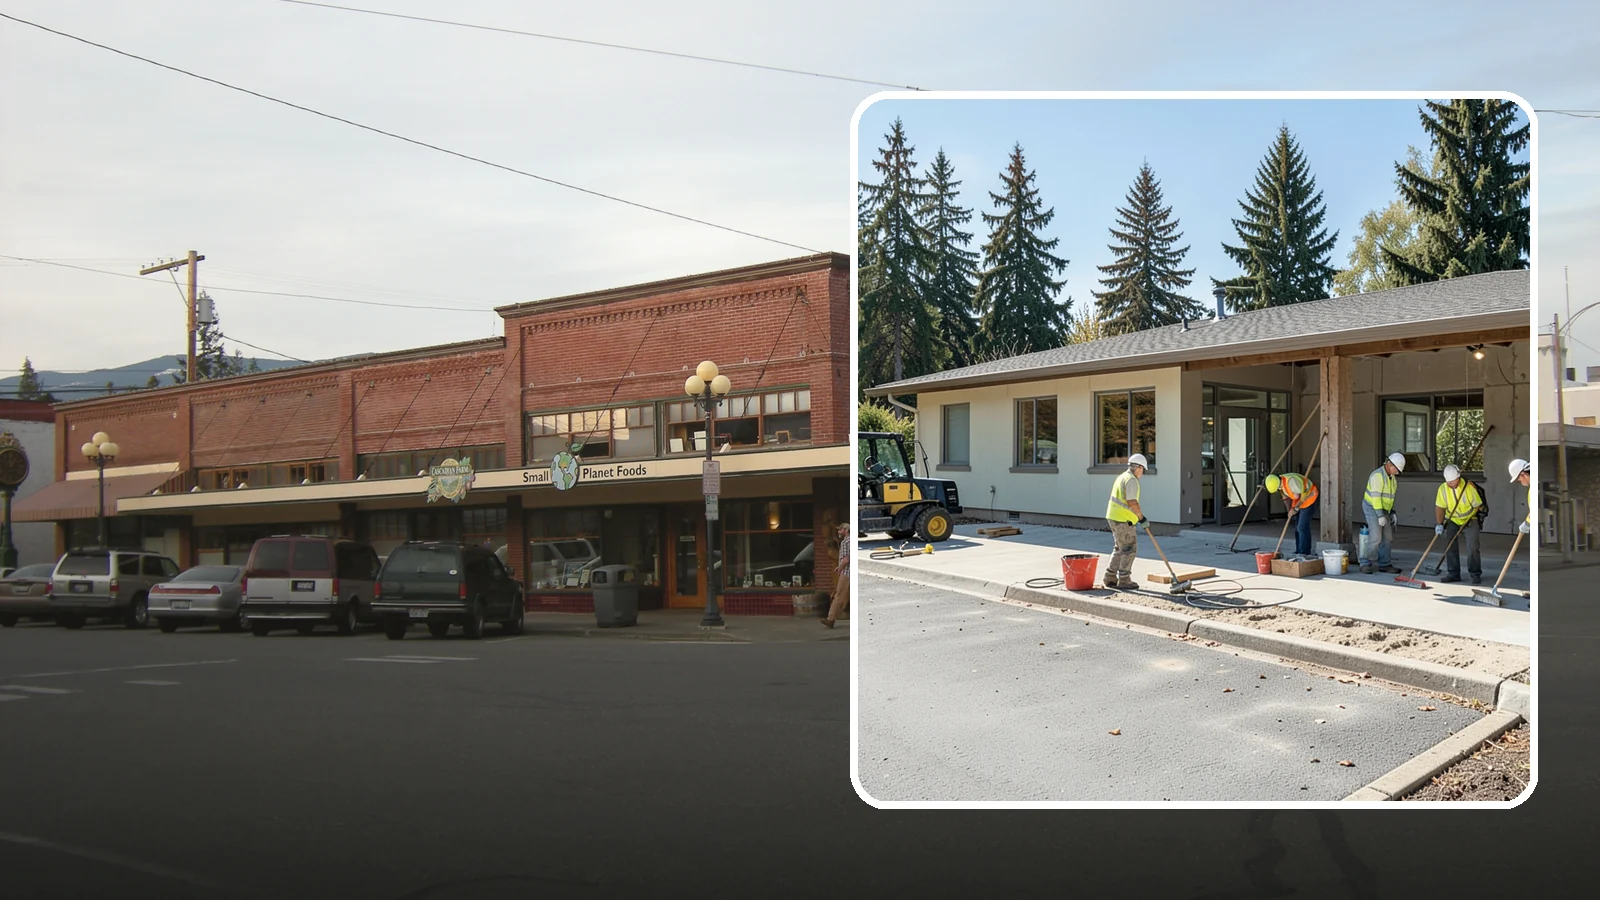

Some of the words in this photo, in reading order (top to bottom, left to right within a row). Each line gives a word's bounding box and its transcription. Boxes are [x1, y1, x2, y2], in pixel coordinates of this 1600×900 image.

[523, 471, 549, 483] Small
[583, 467, 614, 479] Planet
[617, 464, 647, 477] Foods
